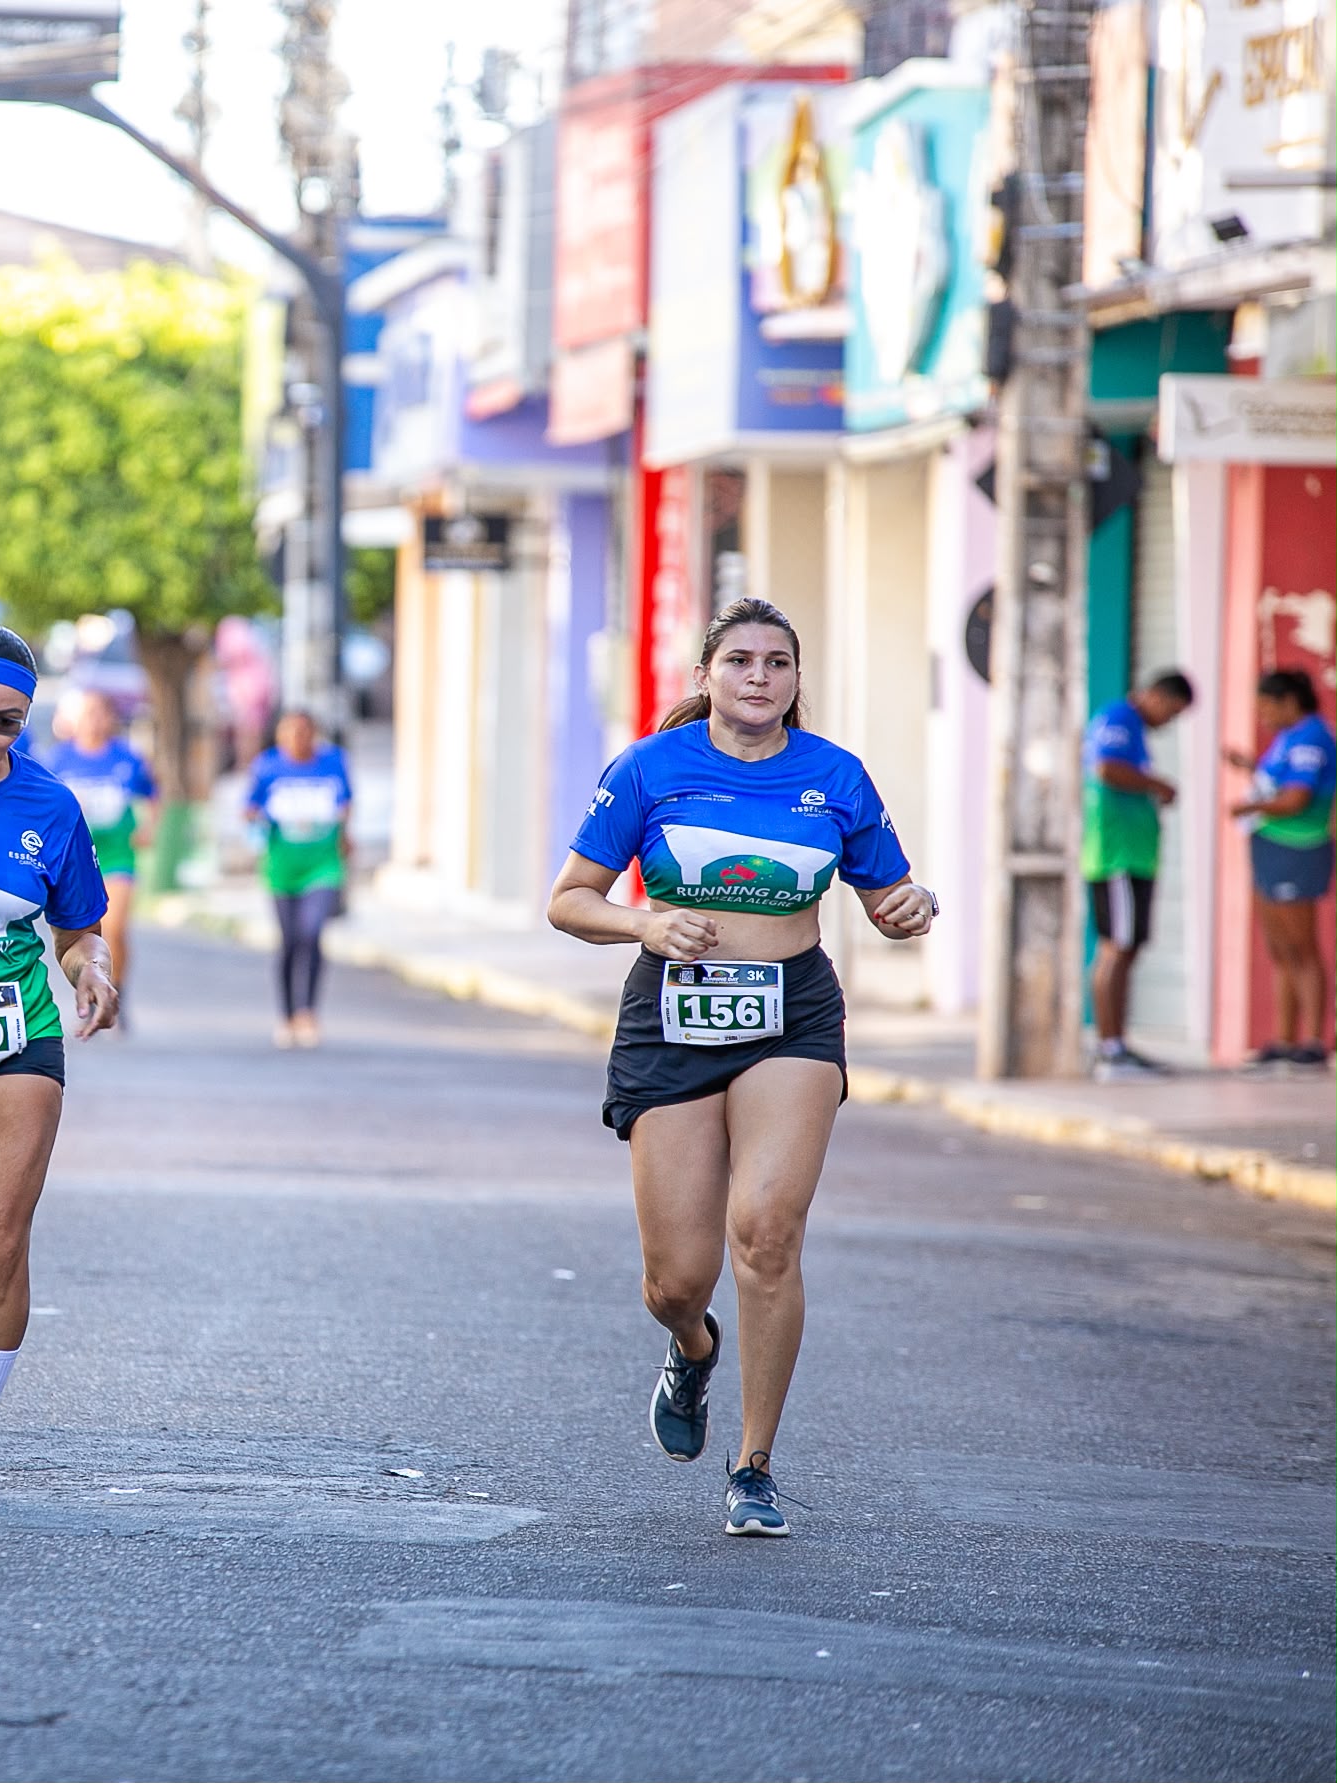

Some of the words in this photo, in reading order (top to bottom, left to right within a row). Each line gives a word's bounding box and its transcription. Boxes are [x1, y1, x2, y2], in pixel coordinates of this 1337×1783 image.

[676, 886, 770, 897] RUNNING
[774, 890, 816, 902] DAY
[745, 897, 794, 907] ALEGRE
[747, 970, 765, 981] 3K
[683, 995, 761, 1028] 156
